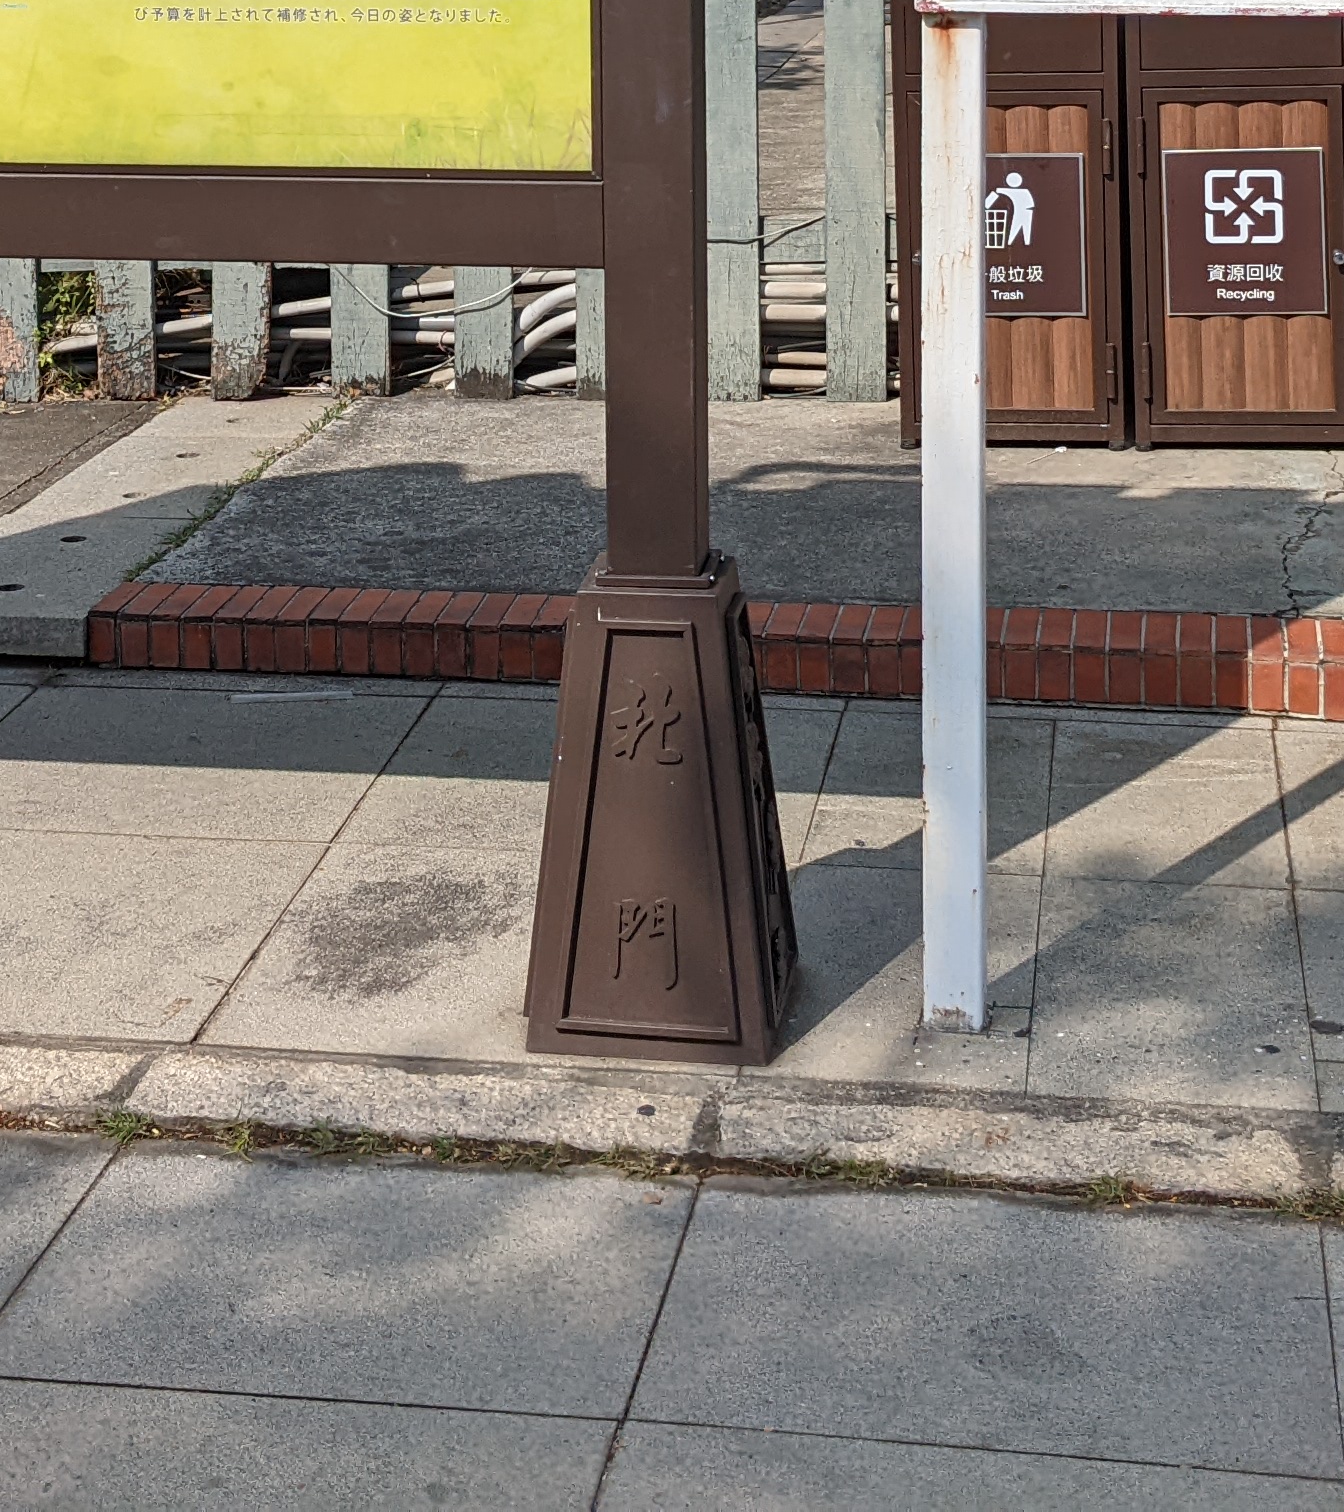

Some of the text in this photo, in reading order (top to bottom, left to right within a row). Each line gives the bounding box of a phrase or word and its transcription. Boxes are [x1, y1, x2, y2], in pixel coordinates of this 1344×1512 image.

[985, 265, 1044, 283] 般垃圾
[1207, 264, 1284, 282] 資源回收
[991, 290, 1024, 300] Trash
[1216, 288, 1275, 301] Recycling
